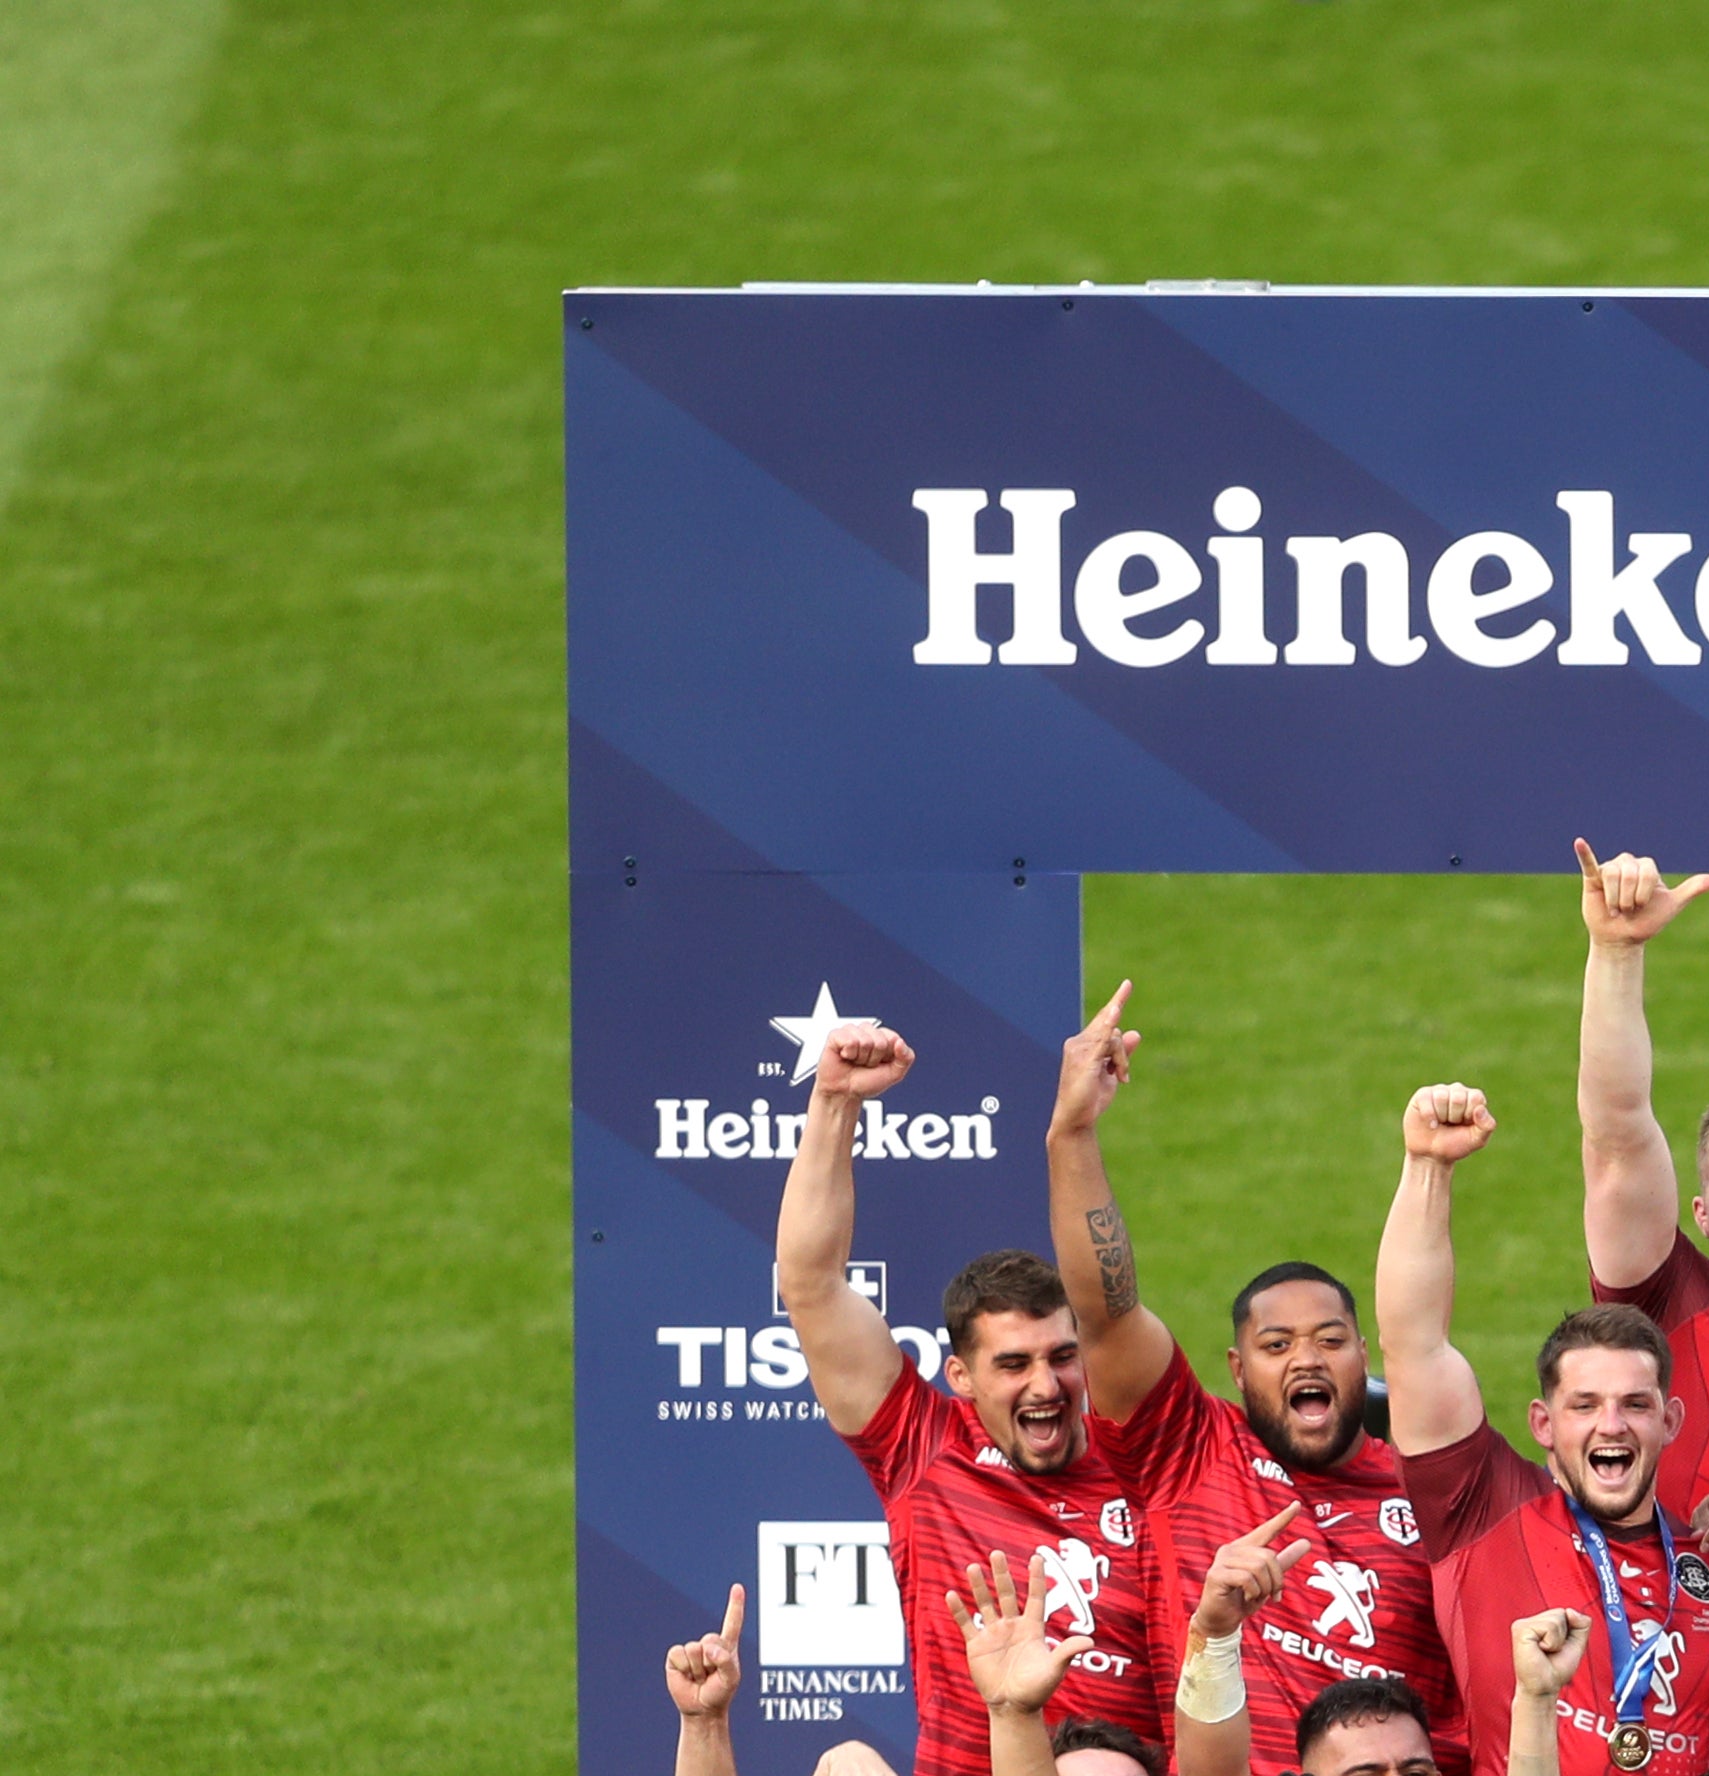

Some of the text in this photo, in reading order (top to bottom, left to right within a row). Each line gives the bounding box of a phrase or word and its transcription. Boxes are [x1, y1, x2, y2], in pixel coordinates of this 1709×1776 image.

[658, 1402, 826, 1422] SWISS WATCH
[1315, 1502, 1332, 1517] 87
[776, 1543, 891, 1607] FT
[760, 1670, 906, 1696] FINANCIAL
[760, 1696, 844, 1722] TIMES
